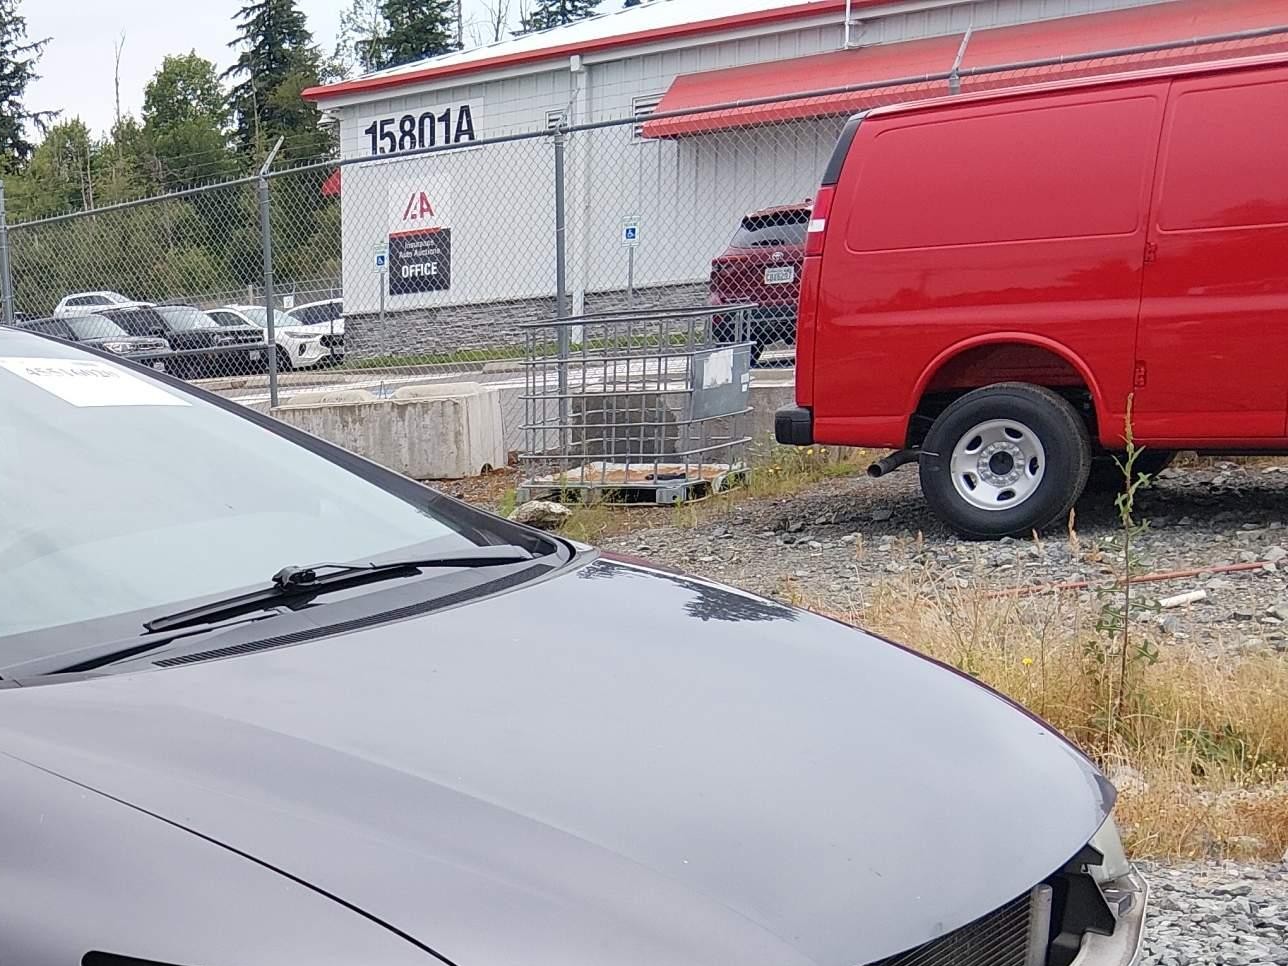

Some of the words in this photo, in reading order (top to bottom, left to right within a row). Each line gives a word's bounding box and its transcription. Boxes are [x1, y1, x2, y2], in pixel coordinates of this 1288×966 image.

[364, 104, 475, 155] 15801A
[404, 240, 435, 249] Insurance
[398, 251, 413, 259] Auto
[413, 247, 441, 257] Auctions
[401, 261, 438, 278] OFFICE
